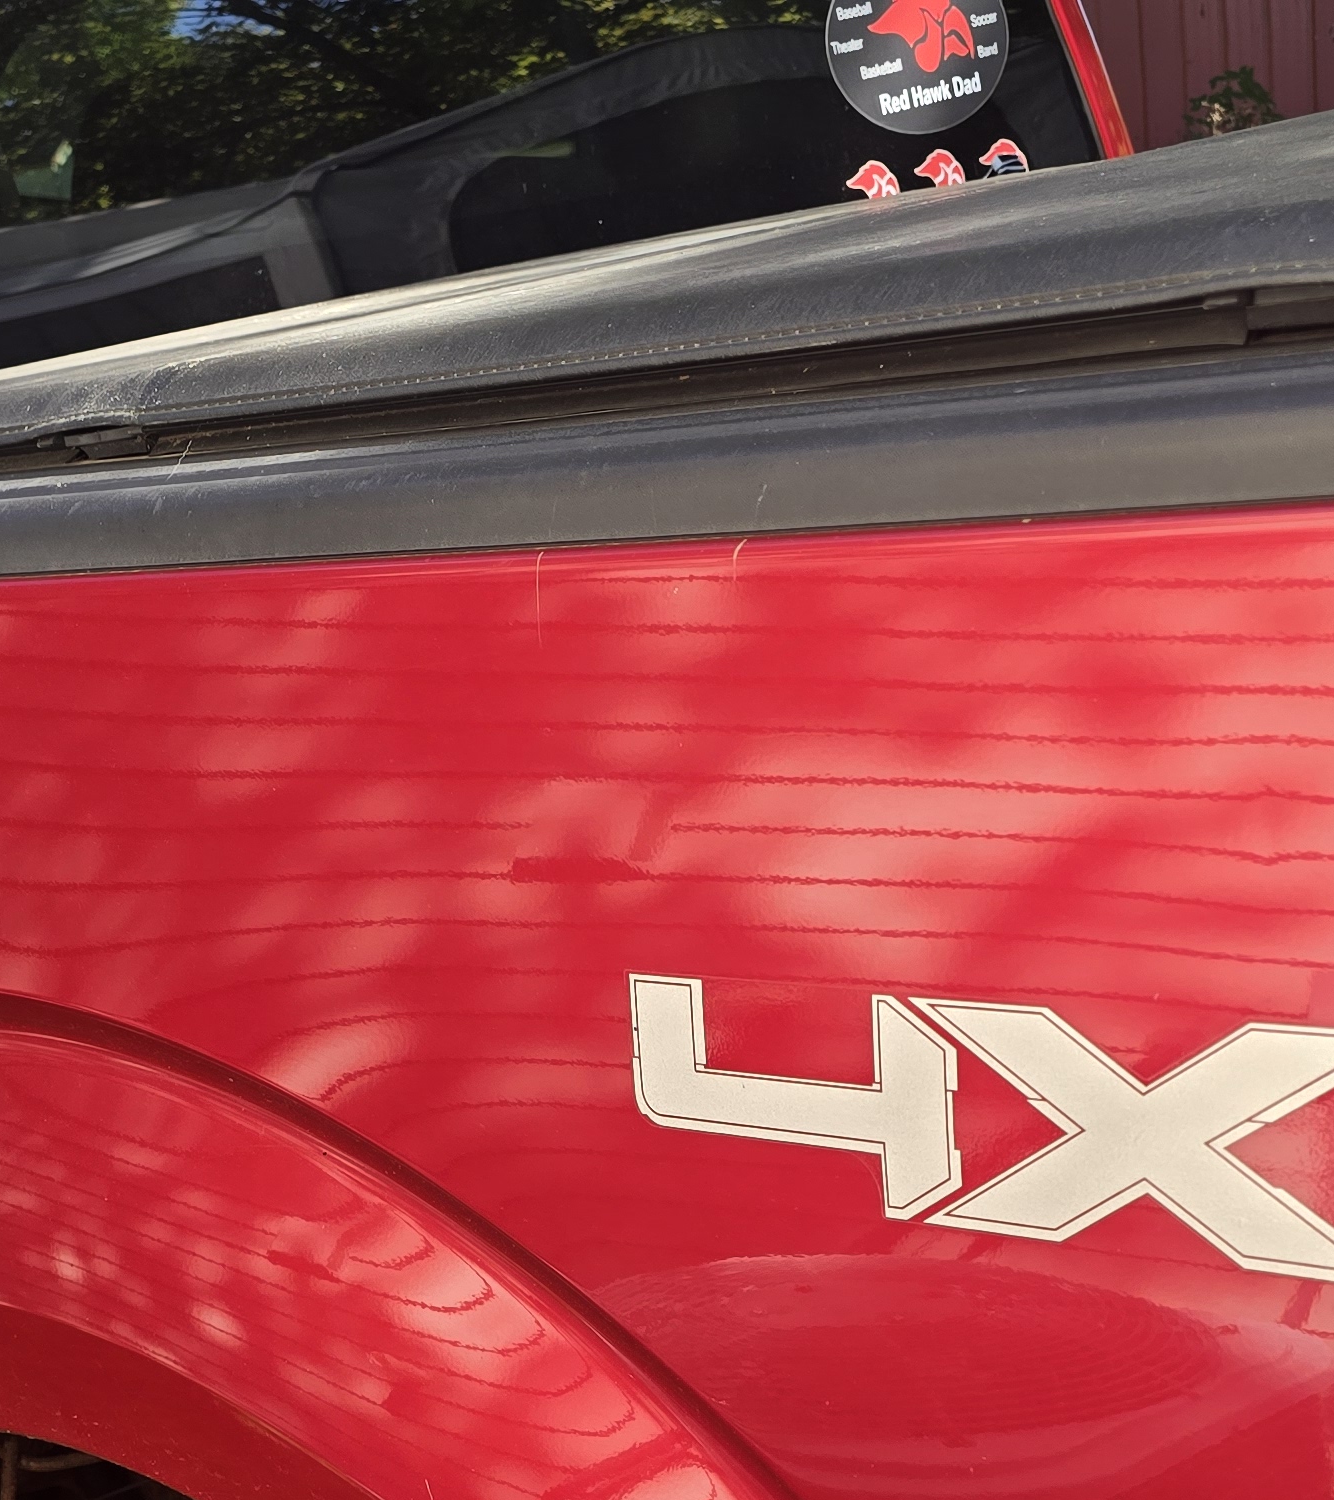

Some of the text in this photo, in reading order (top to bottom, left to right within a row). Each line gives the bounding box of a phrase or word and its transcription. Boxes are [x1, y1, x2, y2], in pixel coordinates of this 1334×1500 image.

[836, 2, 873, 21] Baseball
[970, 12, 998, 28] Soccer
[830, 38, 864, 56] Theater
[860, 58, 903, 80] Basketball
[879, 71, 982, 116] Red Hawk Dad
